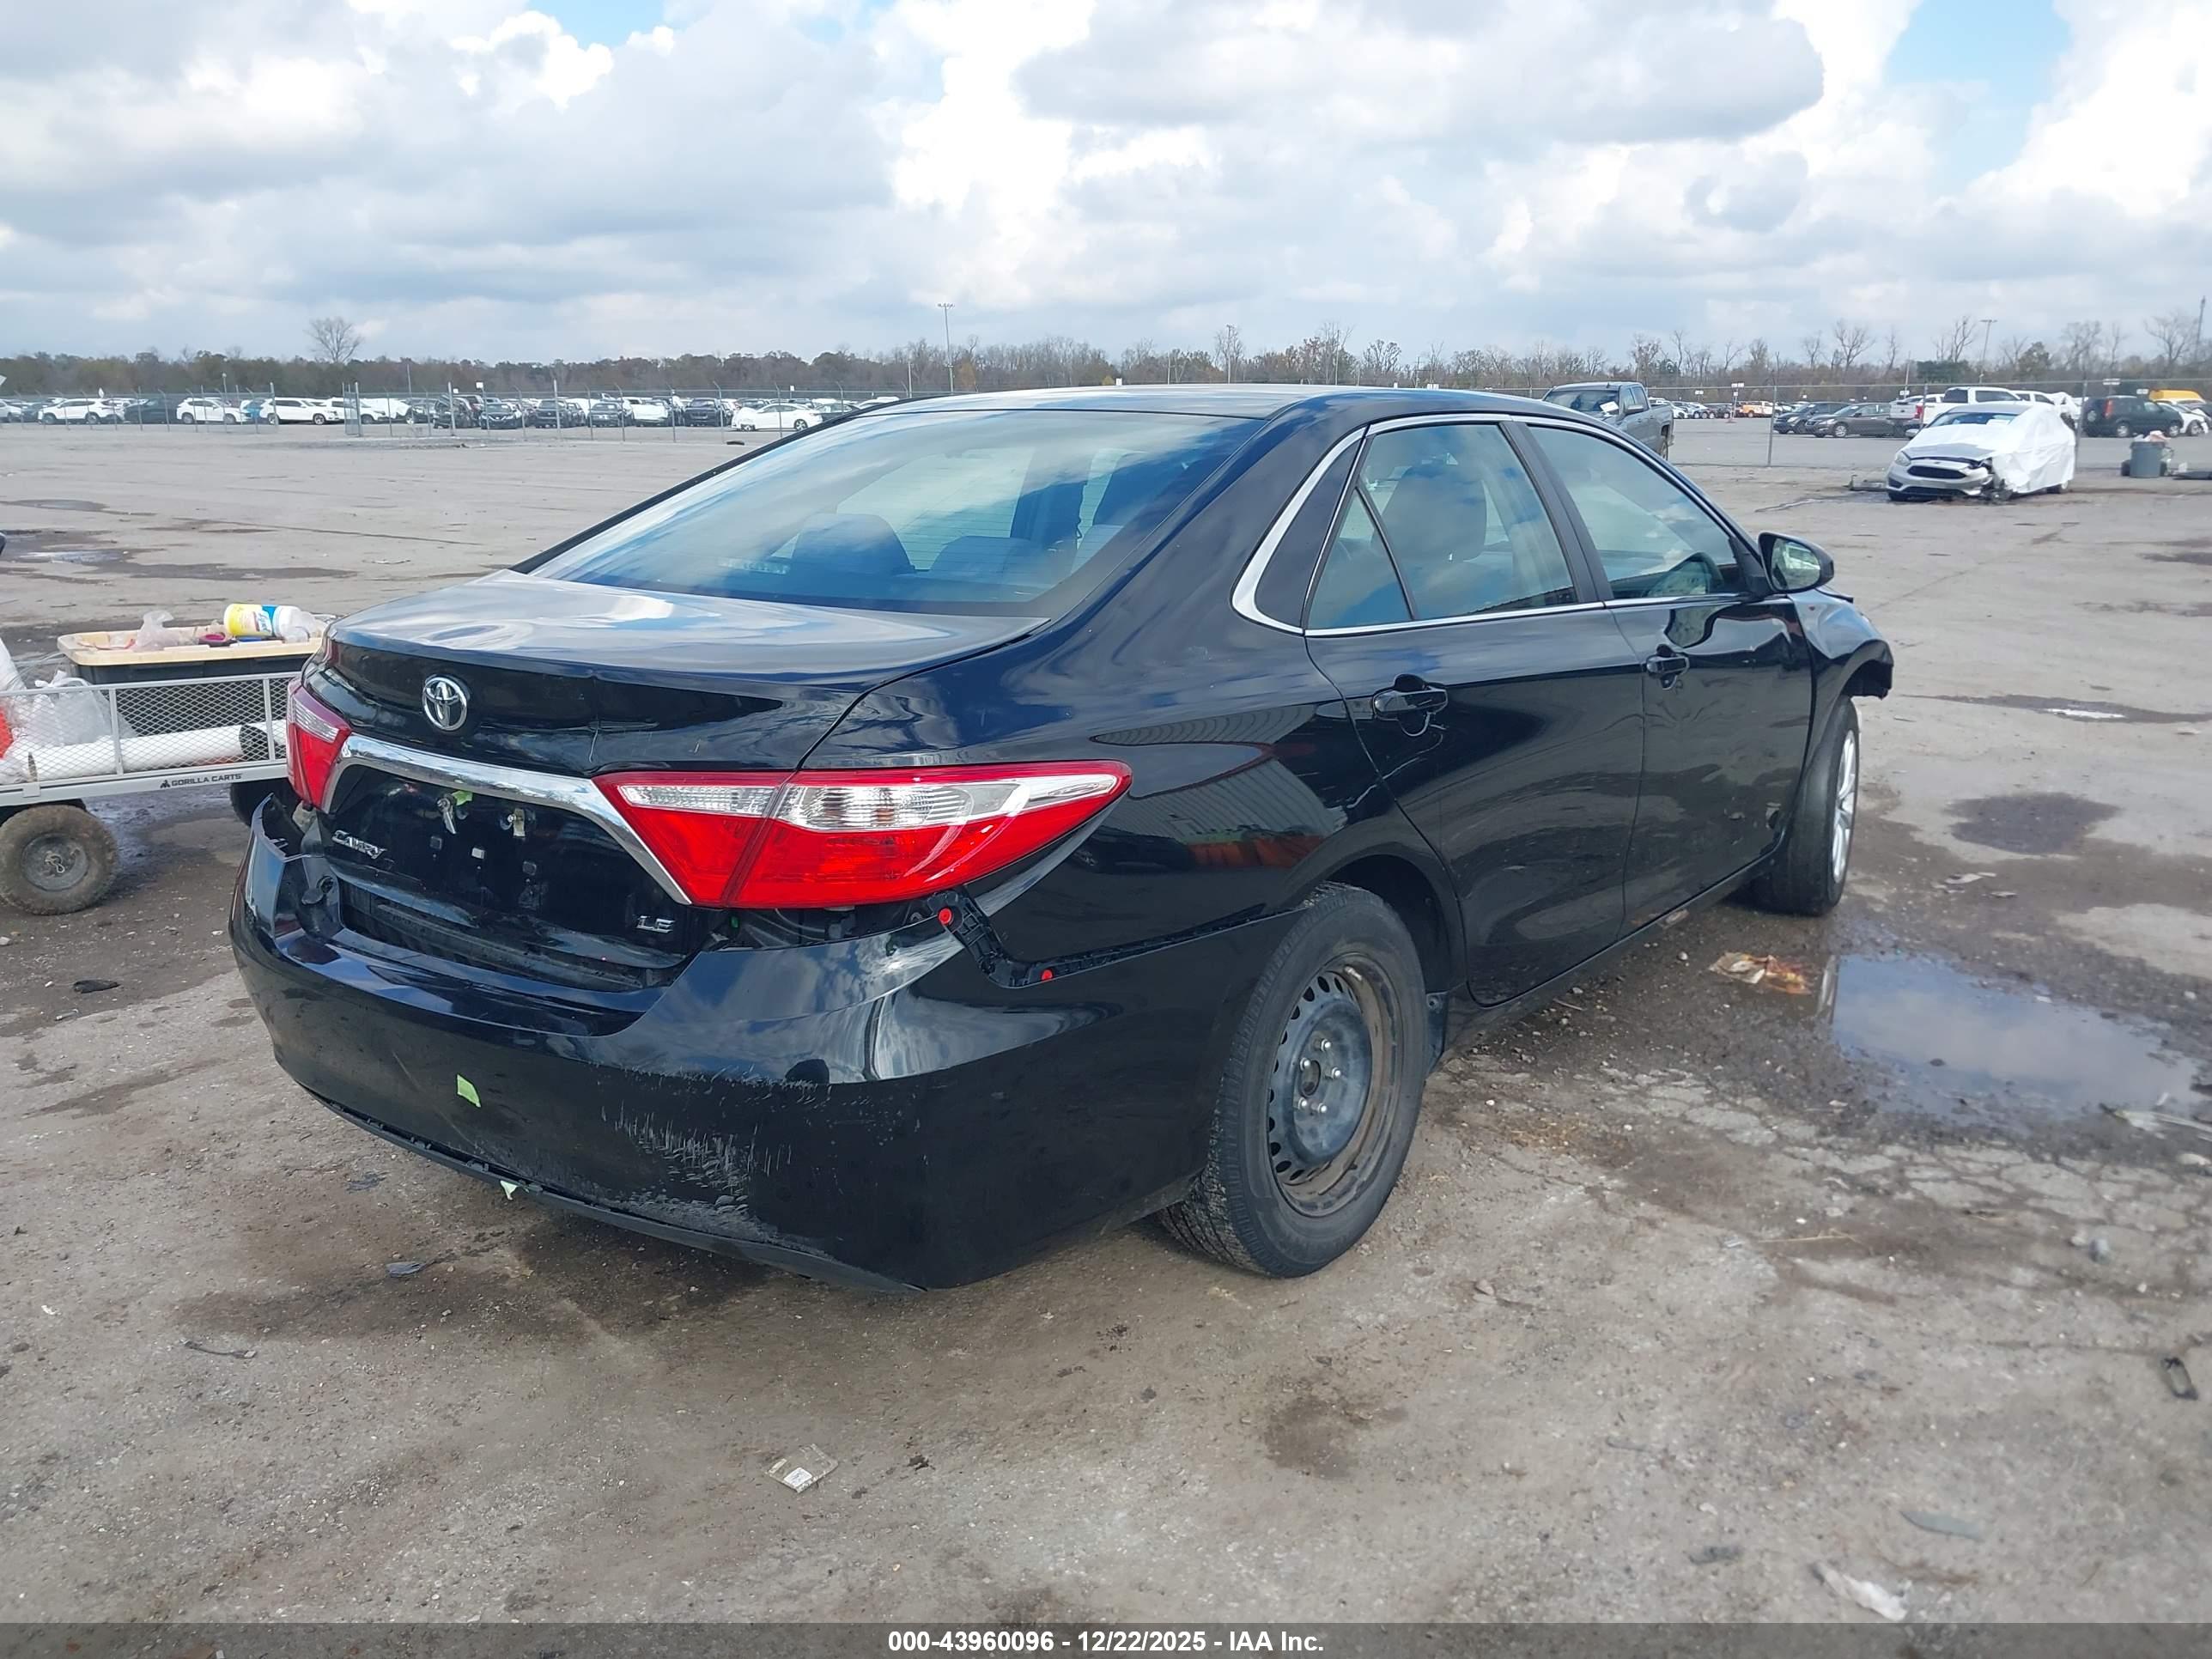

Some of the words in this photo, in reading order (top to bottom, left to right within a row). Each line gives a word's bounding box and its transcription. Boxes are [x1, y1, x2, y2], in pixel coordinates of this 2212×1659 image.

[172, 776, 210, 787] GORILLA
[211, 774, 242, 782] CARTS
[331, 830, 388, 860] CAMRY
[636, 915, 676, 933] LE
